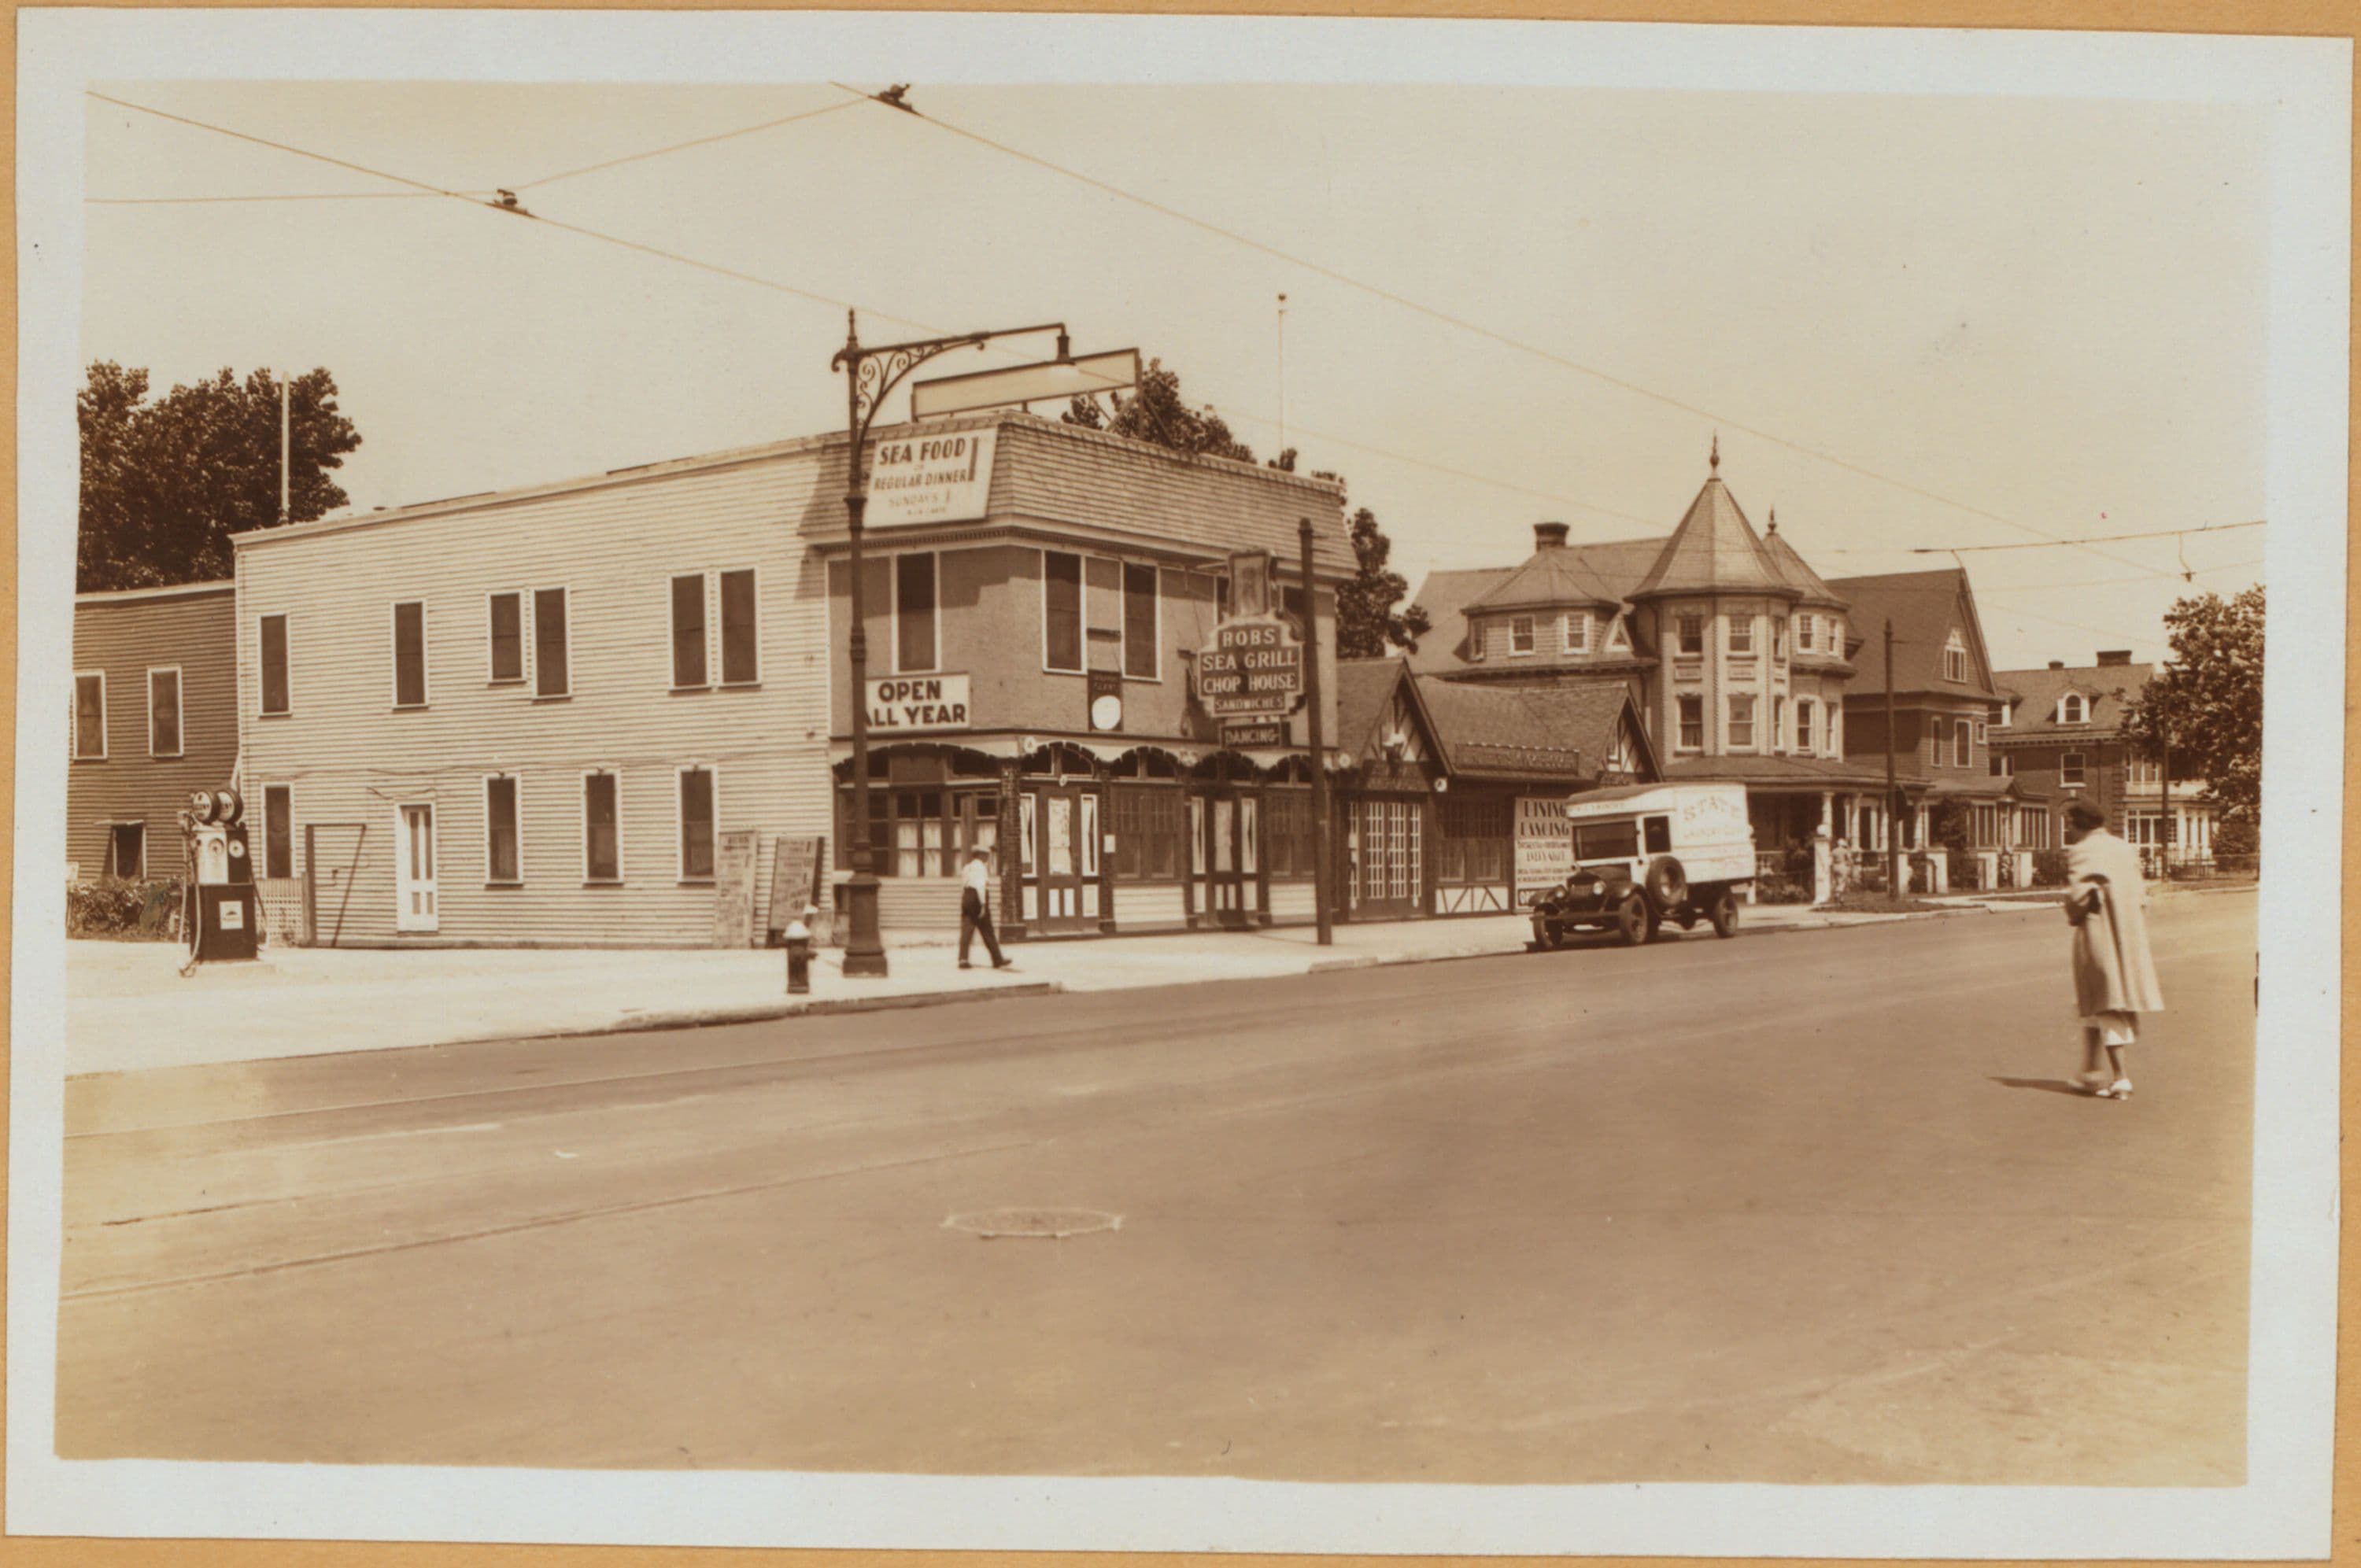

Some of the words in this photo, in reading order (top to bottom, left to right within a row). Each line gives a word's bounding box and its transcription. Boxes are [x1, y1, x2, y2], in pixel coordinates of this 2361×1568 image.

[879, 444, 912, 466] SEA
[920, 437, 966, 461] FOOD
[874, 473, 922, 491] REGULAR
[926, 469, 967, 485] DINNER
[1222, 629, 1276, 647] ROBS
[1202, 655, 1237, 671] SEA
[1244, 651, 1297, 668] GRILL
[878, 681, 941, 702] OPEN
[1203, 676, 1241, 693] CHOP
[1248, 673, 1296, 690] HOUSE
[904, 703, 966, 725] YEAR
[1214, 697, 1284, 711] SANDWICHES
[1225, 729, 1279, 745] DANCING
[1524, 801, 1567, 817] DINING
[1520, 821, 1569, 836] DANCING
